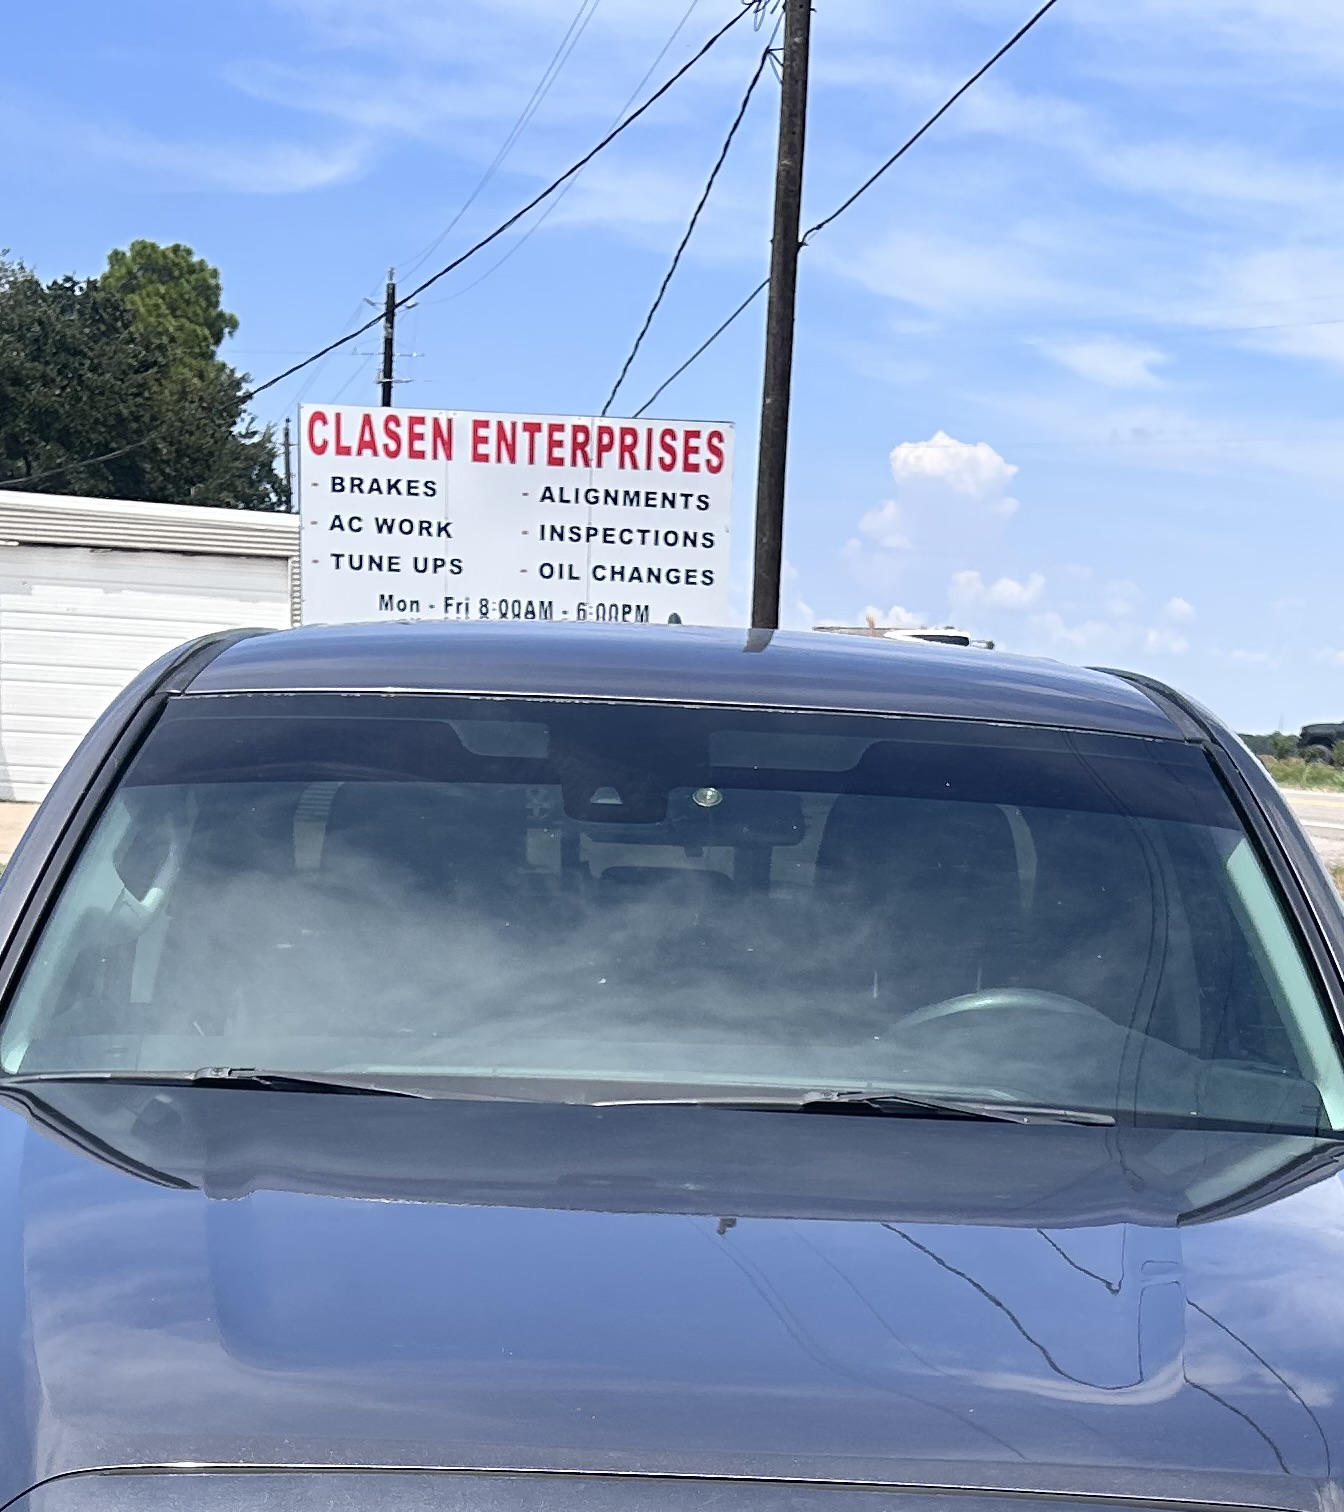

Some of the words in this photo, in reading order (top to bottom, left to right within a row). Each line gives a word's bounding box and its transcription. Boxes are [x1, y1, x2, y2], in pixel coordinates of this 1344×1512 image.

[307, 410, 454, 462] CLASEN
[471, 418, 725, 475] ENTERPRISES
[330, 476, 438, 497] BRAKES
[539, 486, 711, 511] ALIGNMENTS
[329, 514, 364, 533] AC
[374, 517, 454, 539] WORK
[539, 524, 716, 549] INSPECTIONS
[330, 553, 401, 573] TUNE
[413, 556, 464, 575] UPS
[539, 562, 580, 581] OIL
[592, 564, 715, 586] CHANGES
[379, 594, 420, 612] Mon
[444, 596, 470, 615] Fri
[479, 598, 553, 619] 8:00AM
[577, 602, 649, 622] 6:00PM
